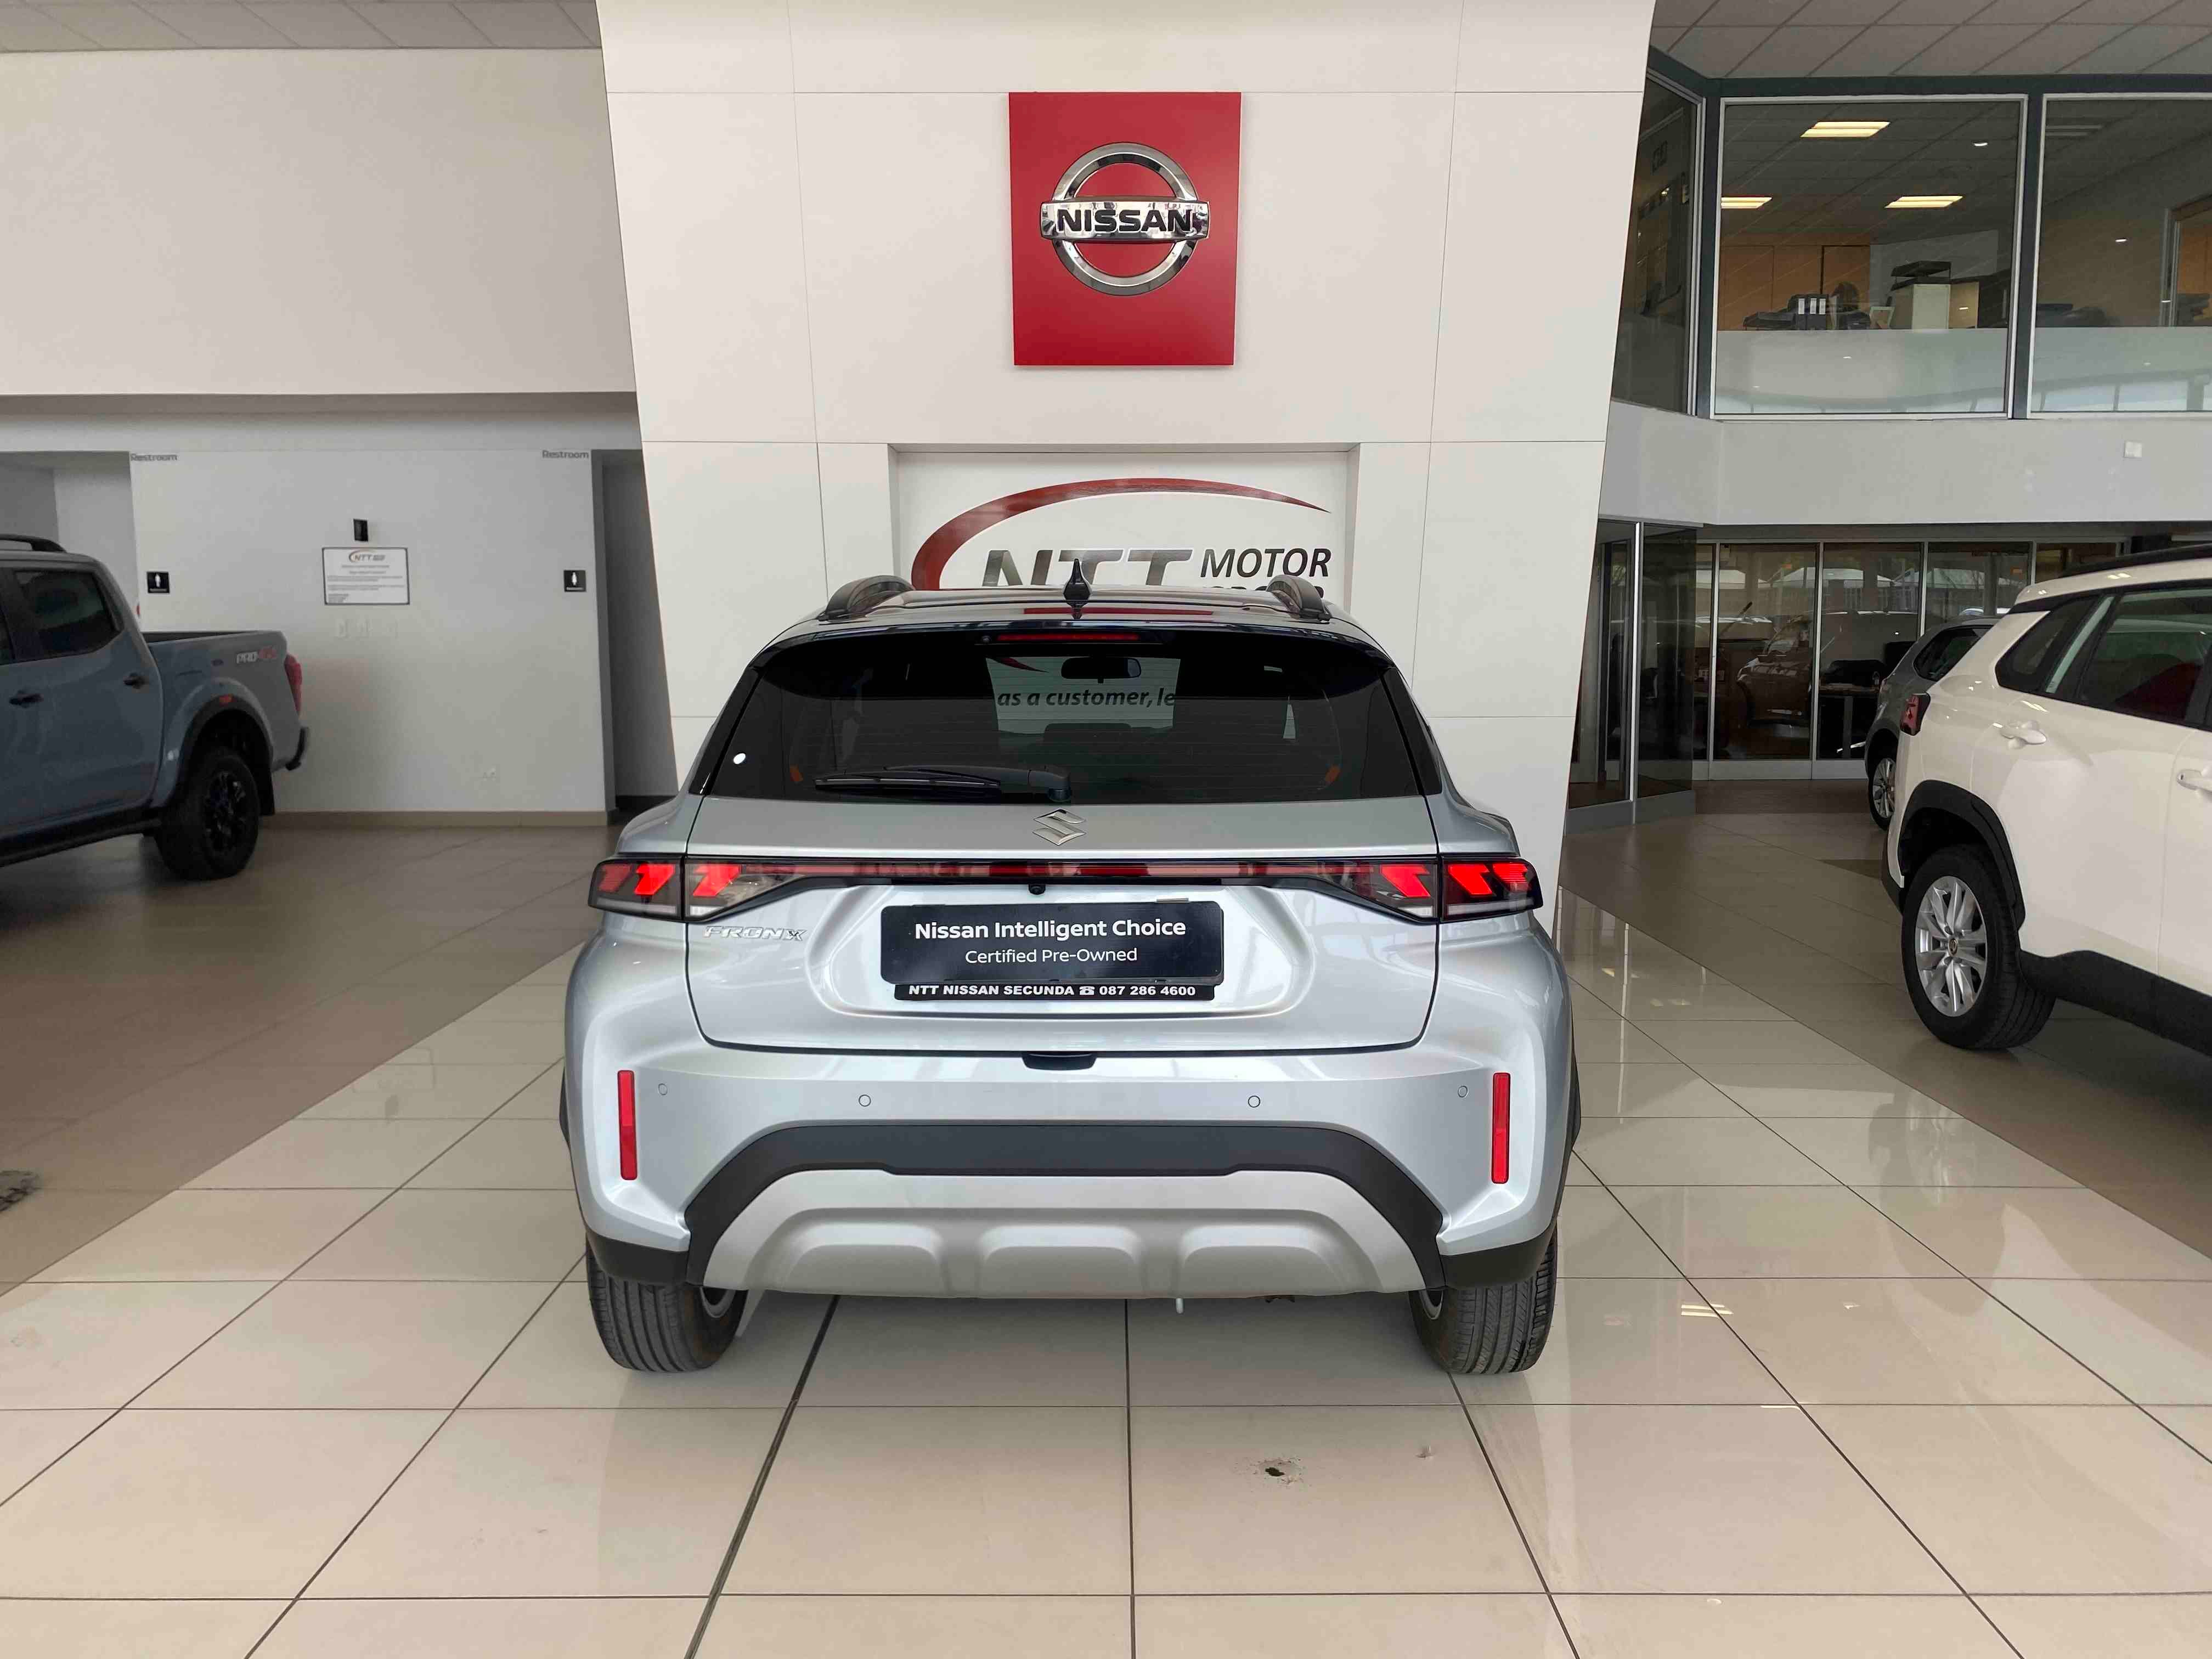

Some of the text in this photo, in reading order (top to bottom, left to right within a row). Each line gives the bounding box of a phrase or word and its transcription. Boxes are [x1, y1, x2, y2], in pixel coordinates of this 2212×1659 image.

[1057, 208, 1192, 232] NISSAN
[131, 453, 177, 461] Restroom
[542, 450, 589, 458] Restroom
[1200, 548, 1332, 578] MOTOR
[997, 692, 1021, 707] as
[1027, 692, 1041, 706] a
[1046, 689, 1153, 708] customer,
[703, 926, 807, 941] FRONX
[915, 918, 1186, 941] Nissan Intelligent Choice
[965, 947, 1137, 963] Certified Pre-Owned
[909, 985, 1196, 996] NTT NISSAN SECUNDA 087 286 4600
